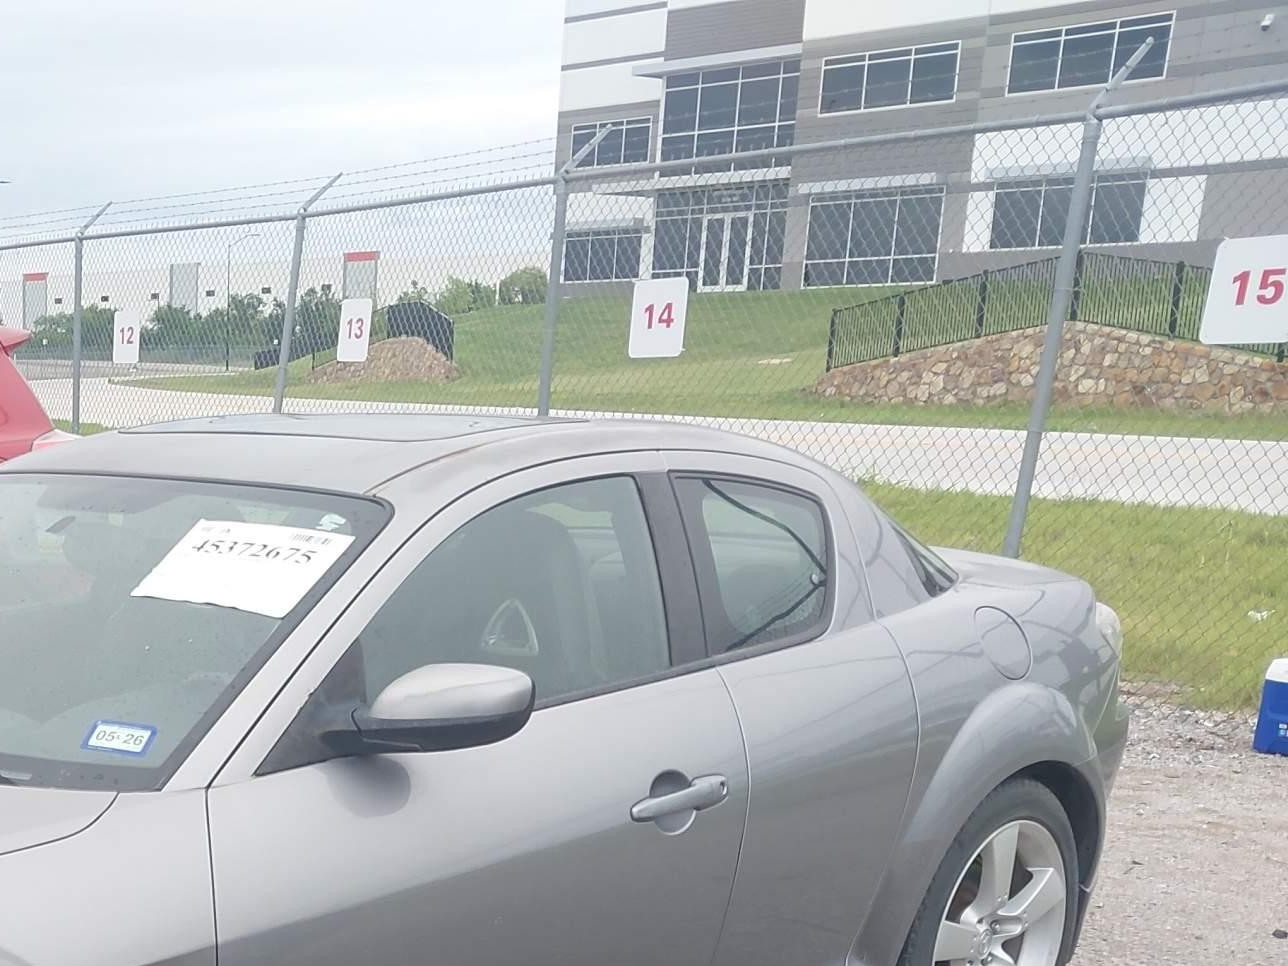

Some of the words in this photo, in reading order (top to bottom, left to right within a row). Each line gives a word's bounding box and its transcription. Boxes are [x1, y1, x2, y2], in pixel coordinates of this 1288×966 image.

[1232, 268, 1287, 306] 15
[347, 317, 364, 340] 13
[644, 302, 675, 330] 14
[119, 326, 134, 345] 12
[191, 538, 319, 565] 45372675
